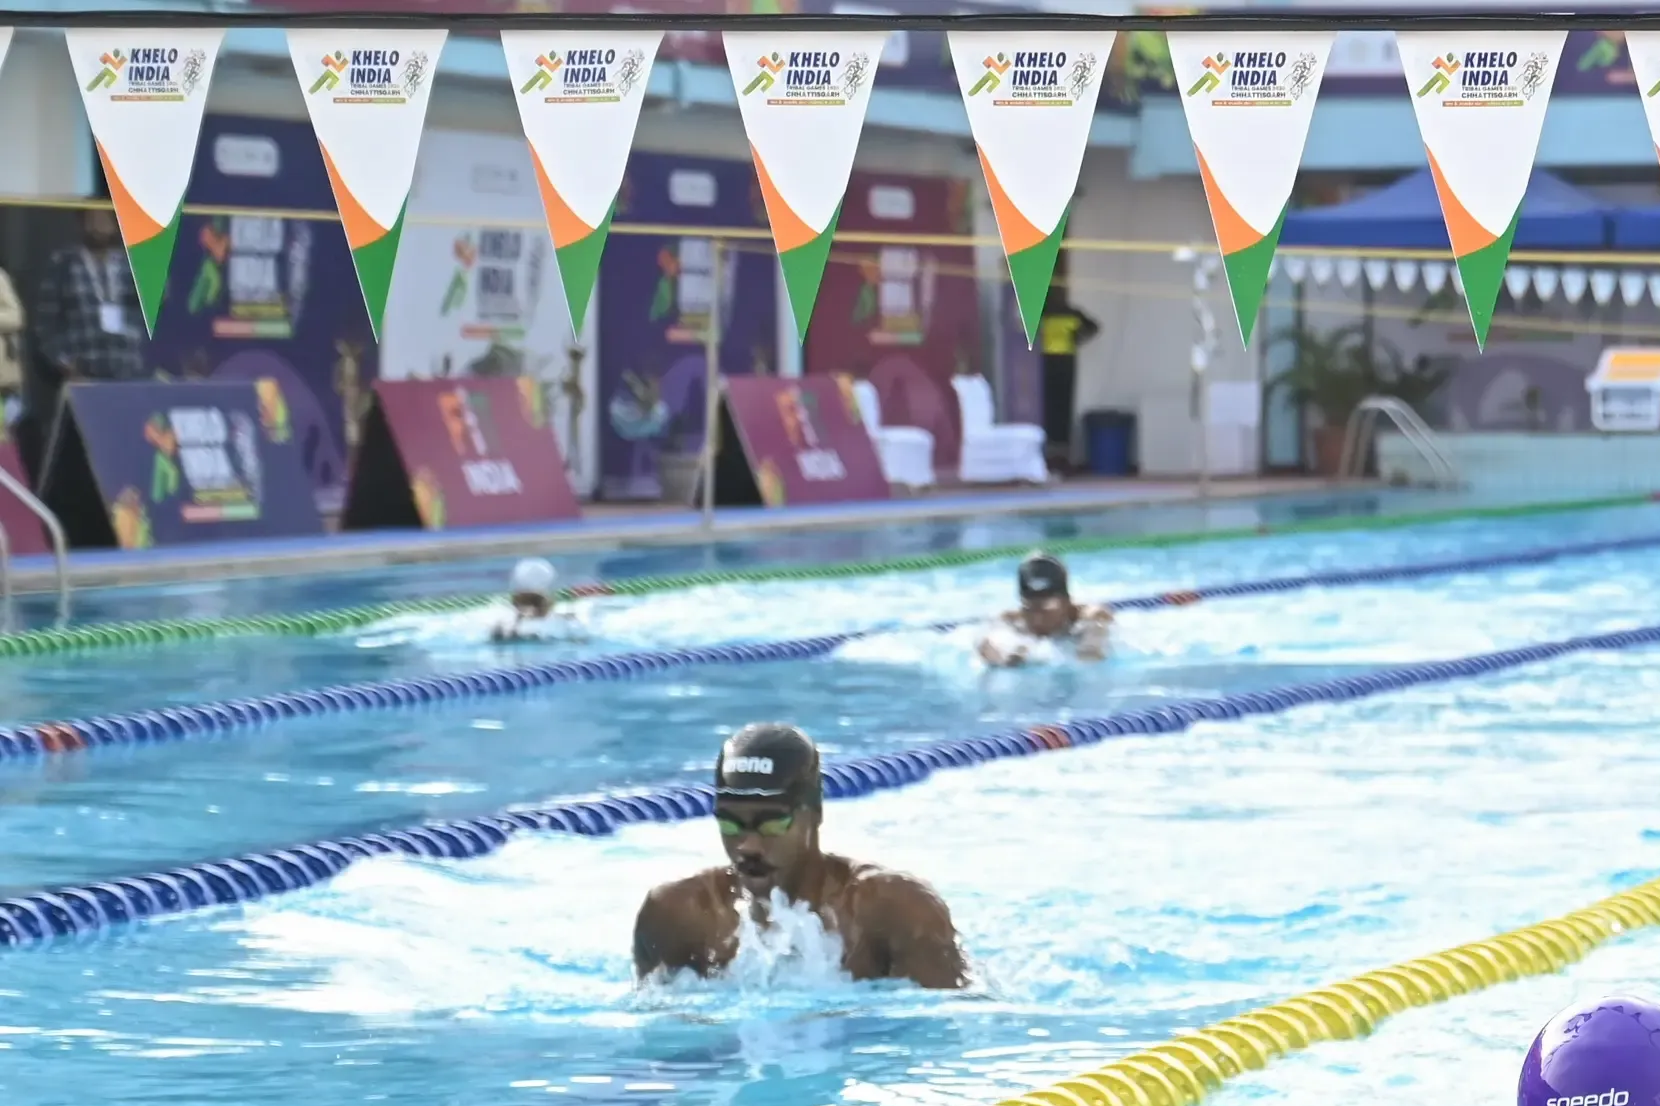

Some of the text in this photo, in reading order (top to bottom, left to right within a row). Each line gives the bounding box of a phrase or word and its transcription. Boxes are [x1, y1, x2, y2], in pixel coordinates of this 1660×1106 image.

[130, 48, 178, 64] KHELO
[352, 50, 399, 66] KHELO
[567, 49, 615, 65] KHELO
[789, 52, 840, 67] KHELO
[1015, 52, 1066, 68] KHELO
[1234, 52, 1286, 68] KHELO
[1464, 52, 1517, 68] KHELO
[129, 66, 170, 81] INDIA
[351, 68, 391, 83] INDIA
[564, 67, 606, 83] INDIA
[787, 70, 831, 85] INDIA
[1013, 70, 1057, 85] INDIA
[1232, 70, 1277, 86] INDIA
[1462, 70, 1508, 86] INDIA
